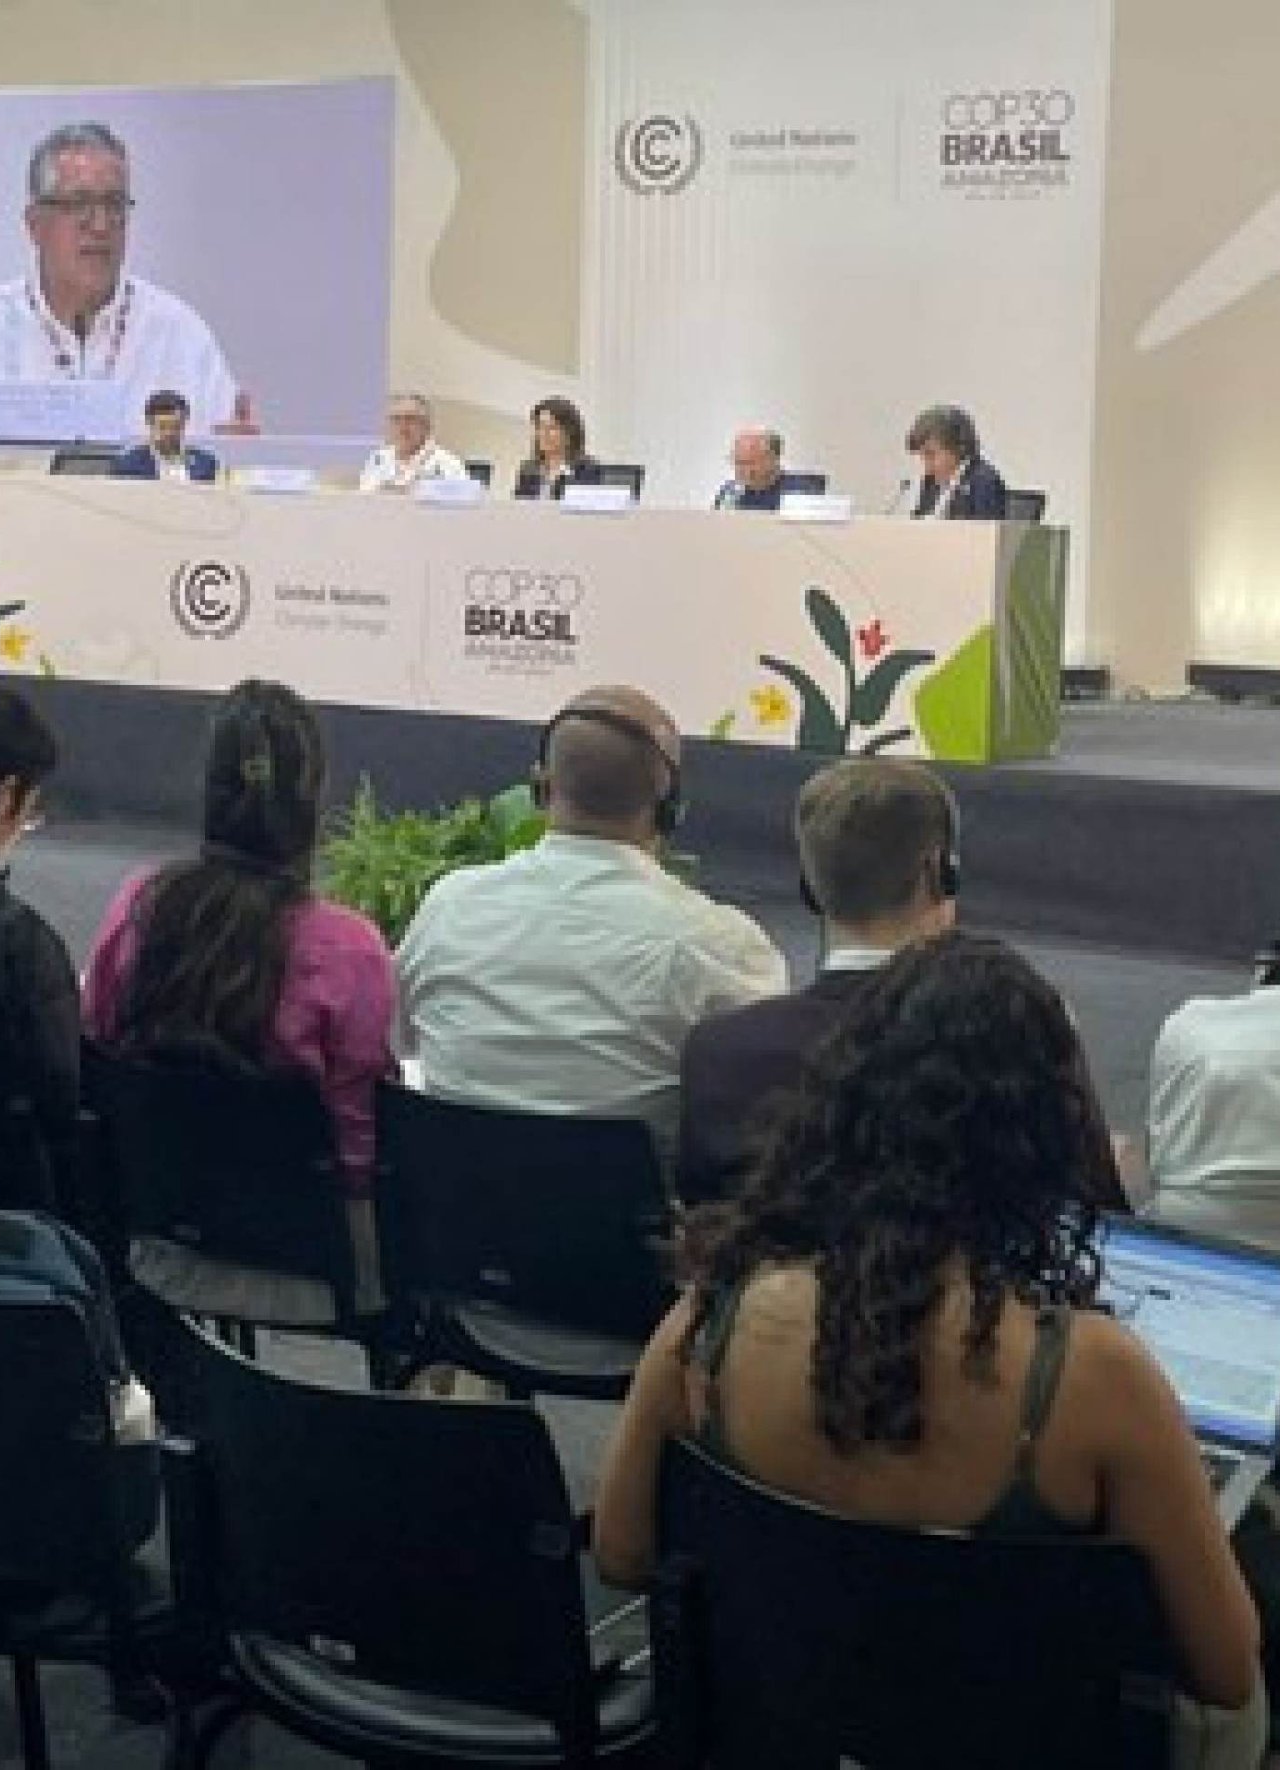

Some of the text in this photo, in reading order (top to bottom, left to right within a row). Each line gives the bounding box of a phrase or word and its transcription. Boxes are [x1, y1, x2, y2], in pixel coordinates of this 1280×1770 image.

[942, 90, 1075, 129] COP30
[941, 131, 1071, 165] BRASIL
[465, 567, 585, 606] COP30
[464, 604, 578, 644] BRASIL
